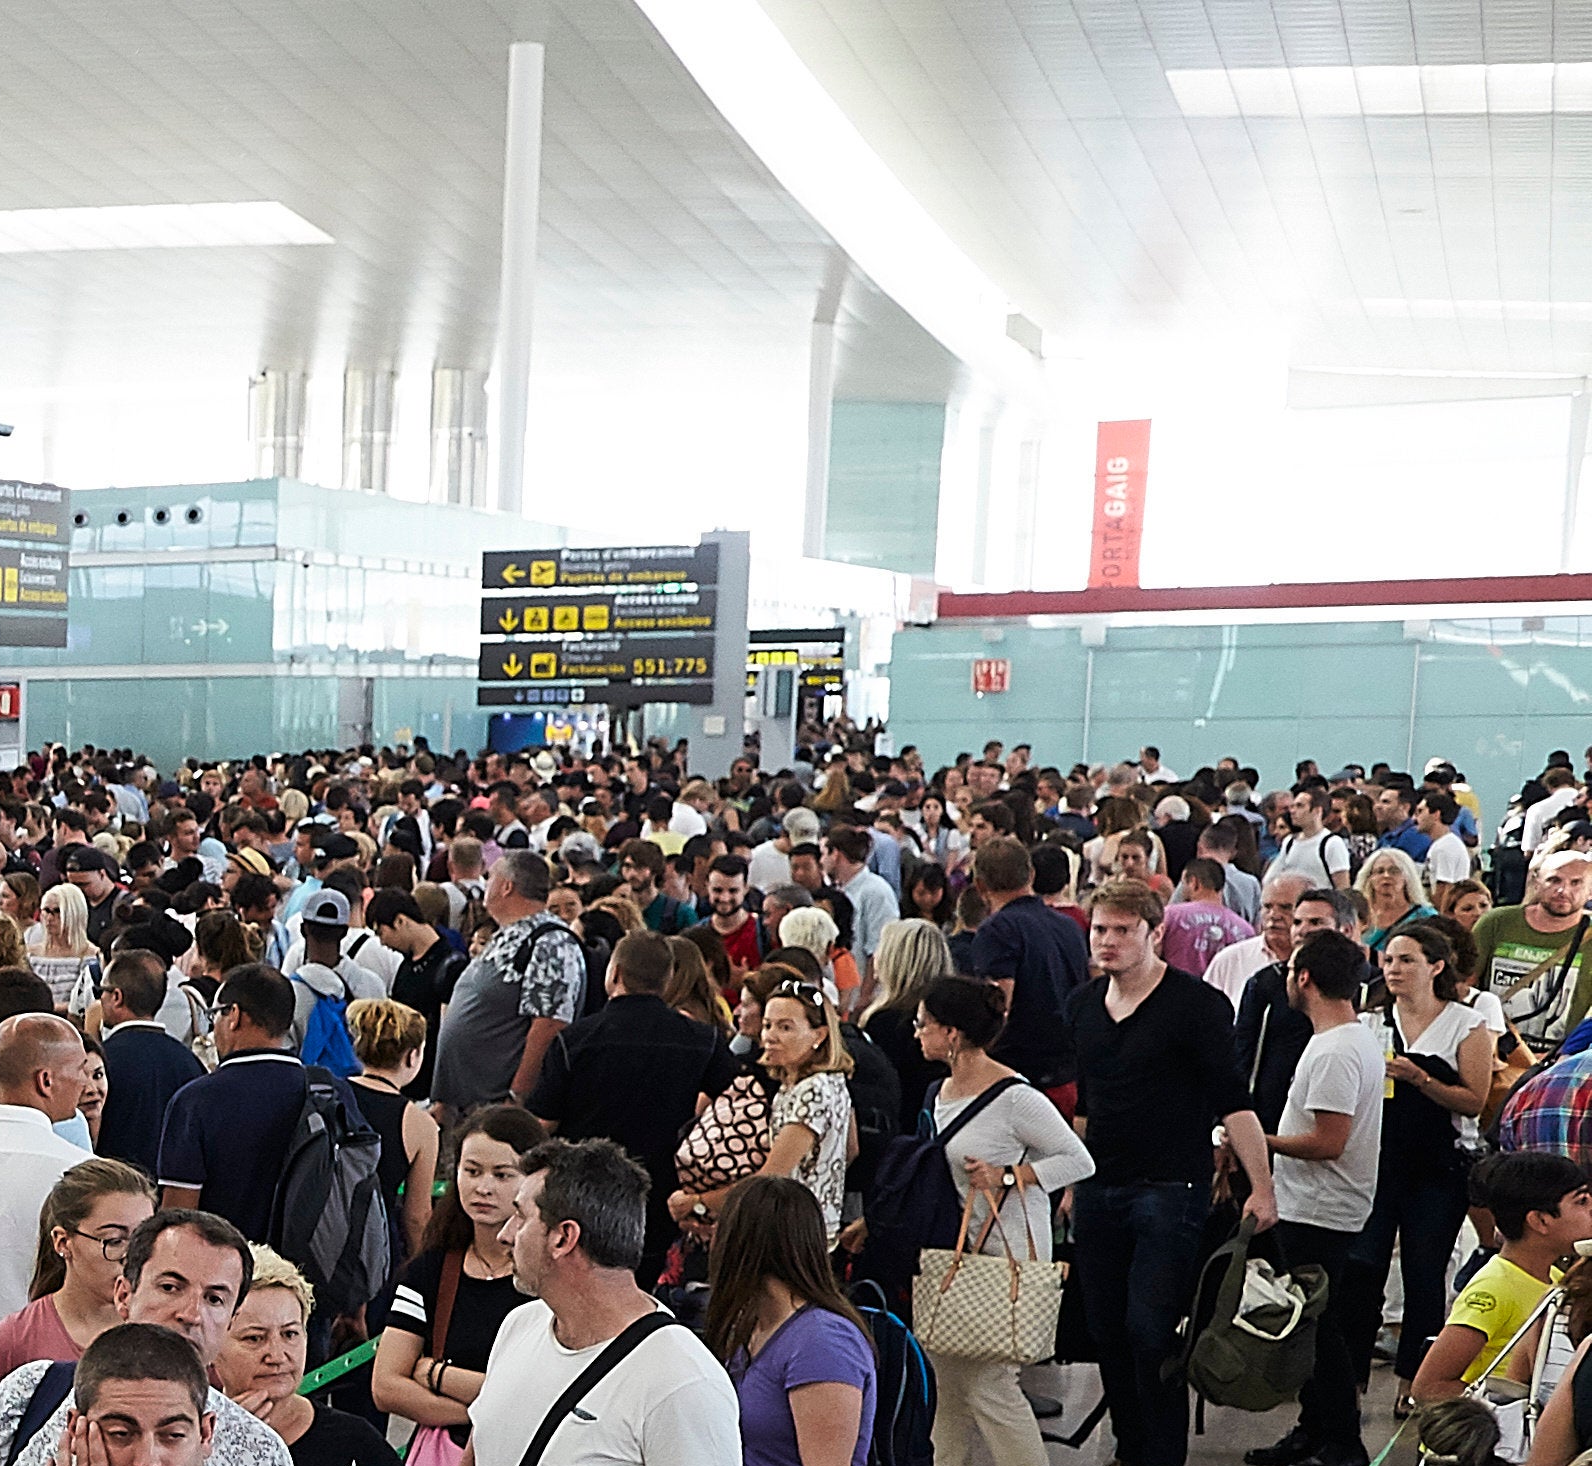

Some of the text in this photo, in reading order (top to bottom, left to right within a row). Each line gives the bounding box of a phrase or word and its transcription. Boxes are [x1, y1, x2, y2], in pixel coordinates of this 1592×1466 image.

[1103, 456, 1129, 517] GAIG
[633, 657, 707, 675] 551 775
